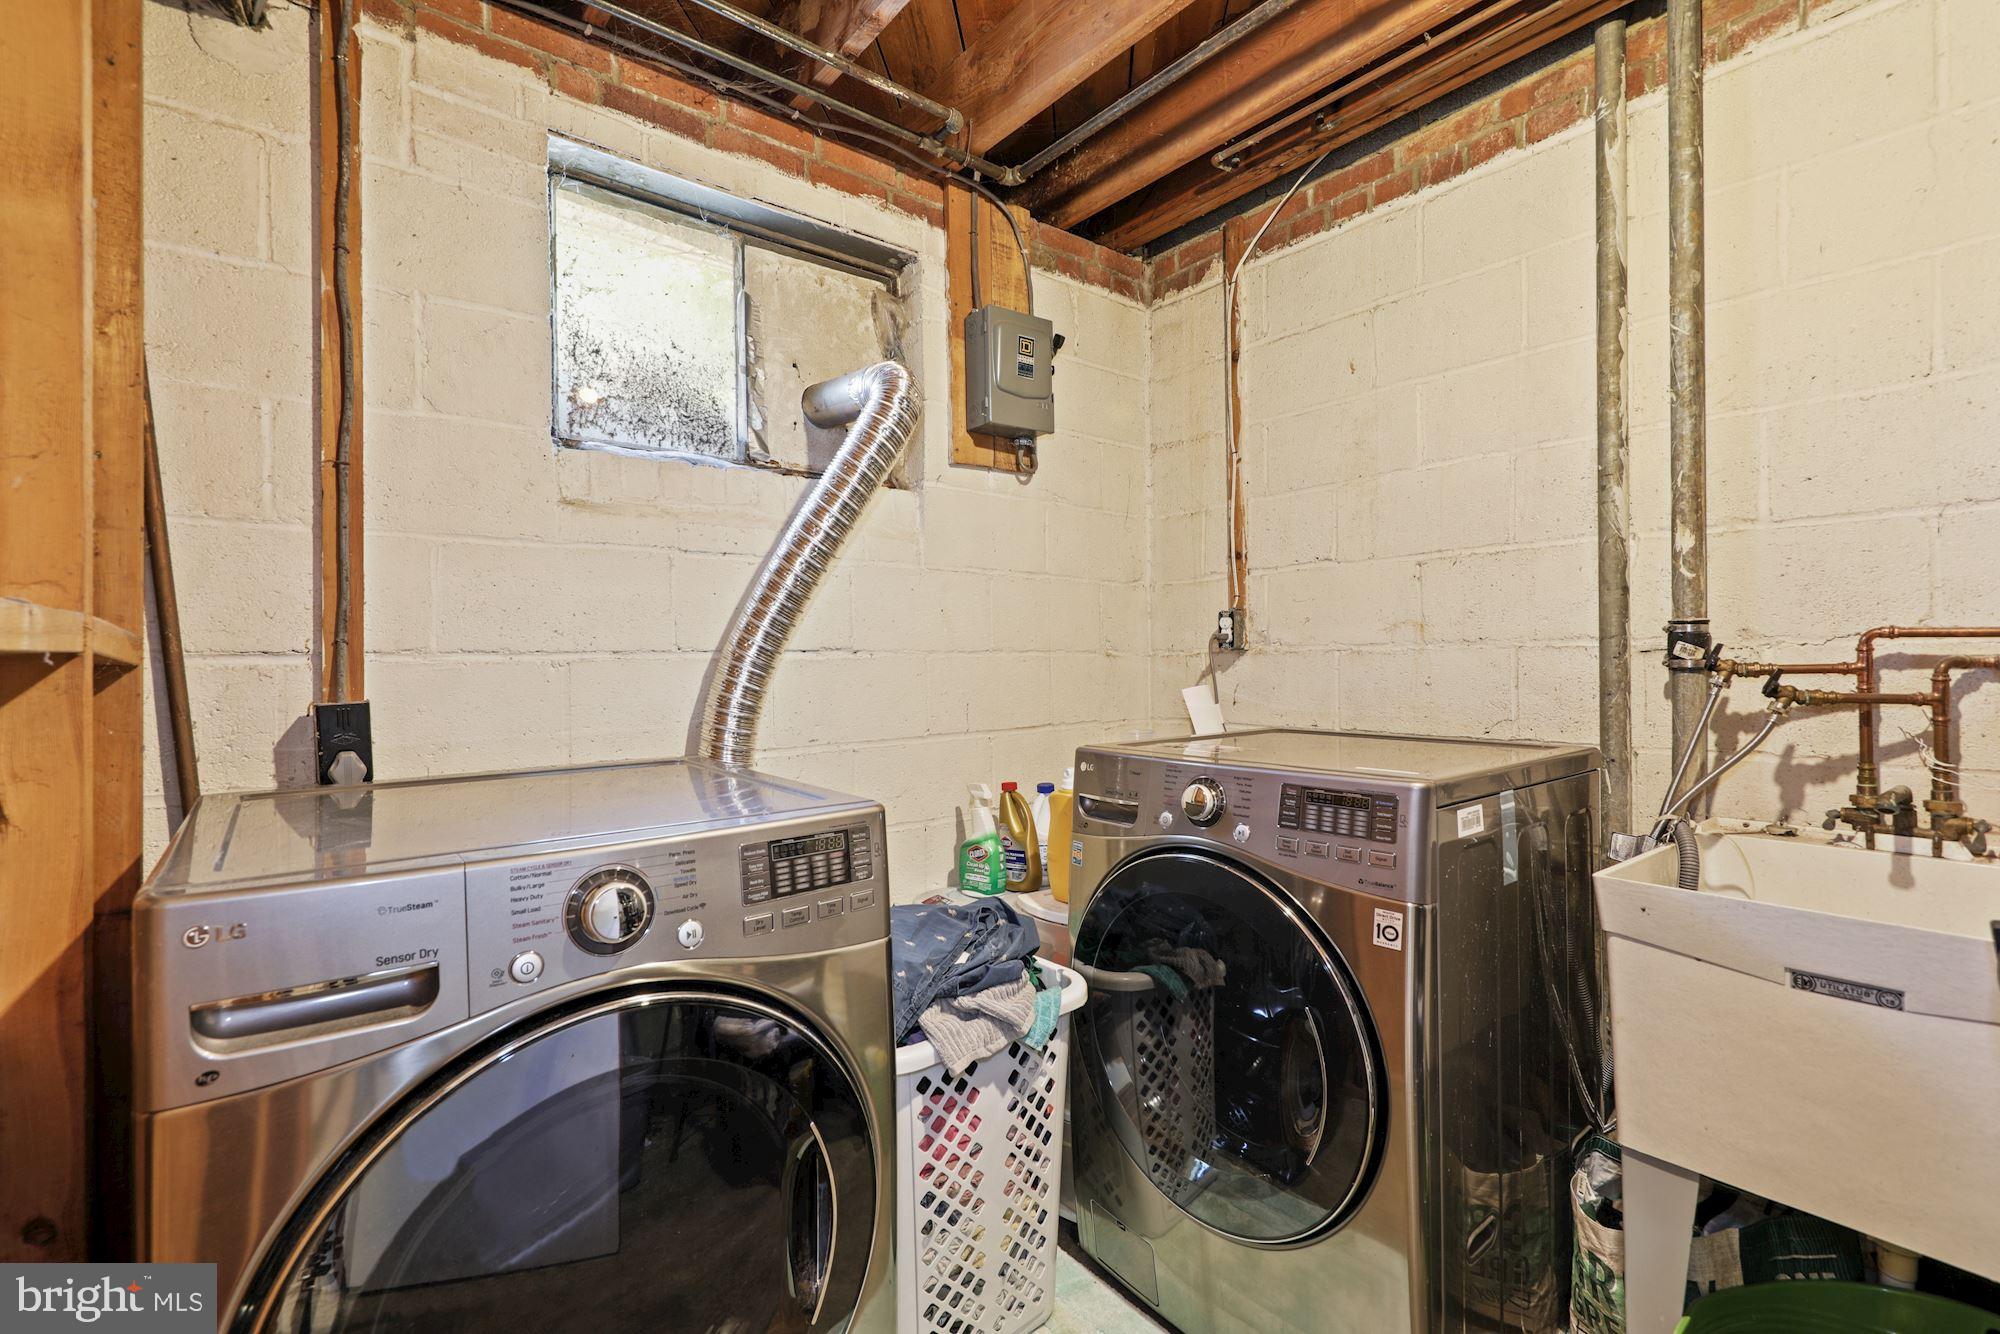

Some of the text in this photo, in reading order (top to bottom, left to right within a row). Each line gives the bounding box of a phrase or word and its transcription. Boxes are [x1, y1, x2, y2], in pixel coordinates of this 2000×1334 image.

[1086, 763, 1095, 772] LG
[509, 870, 552, 882] Cotton/Normal
[529, 893, 544, 901] Duty
[215, 923, 247, 942] LG
[1376, 923, 1399, 942] 10
[375, 948, 439, 967] Sensor Dry
